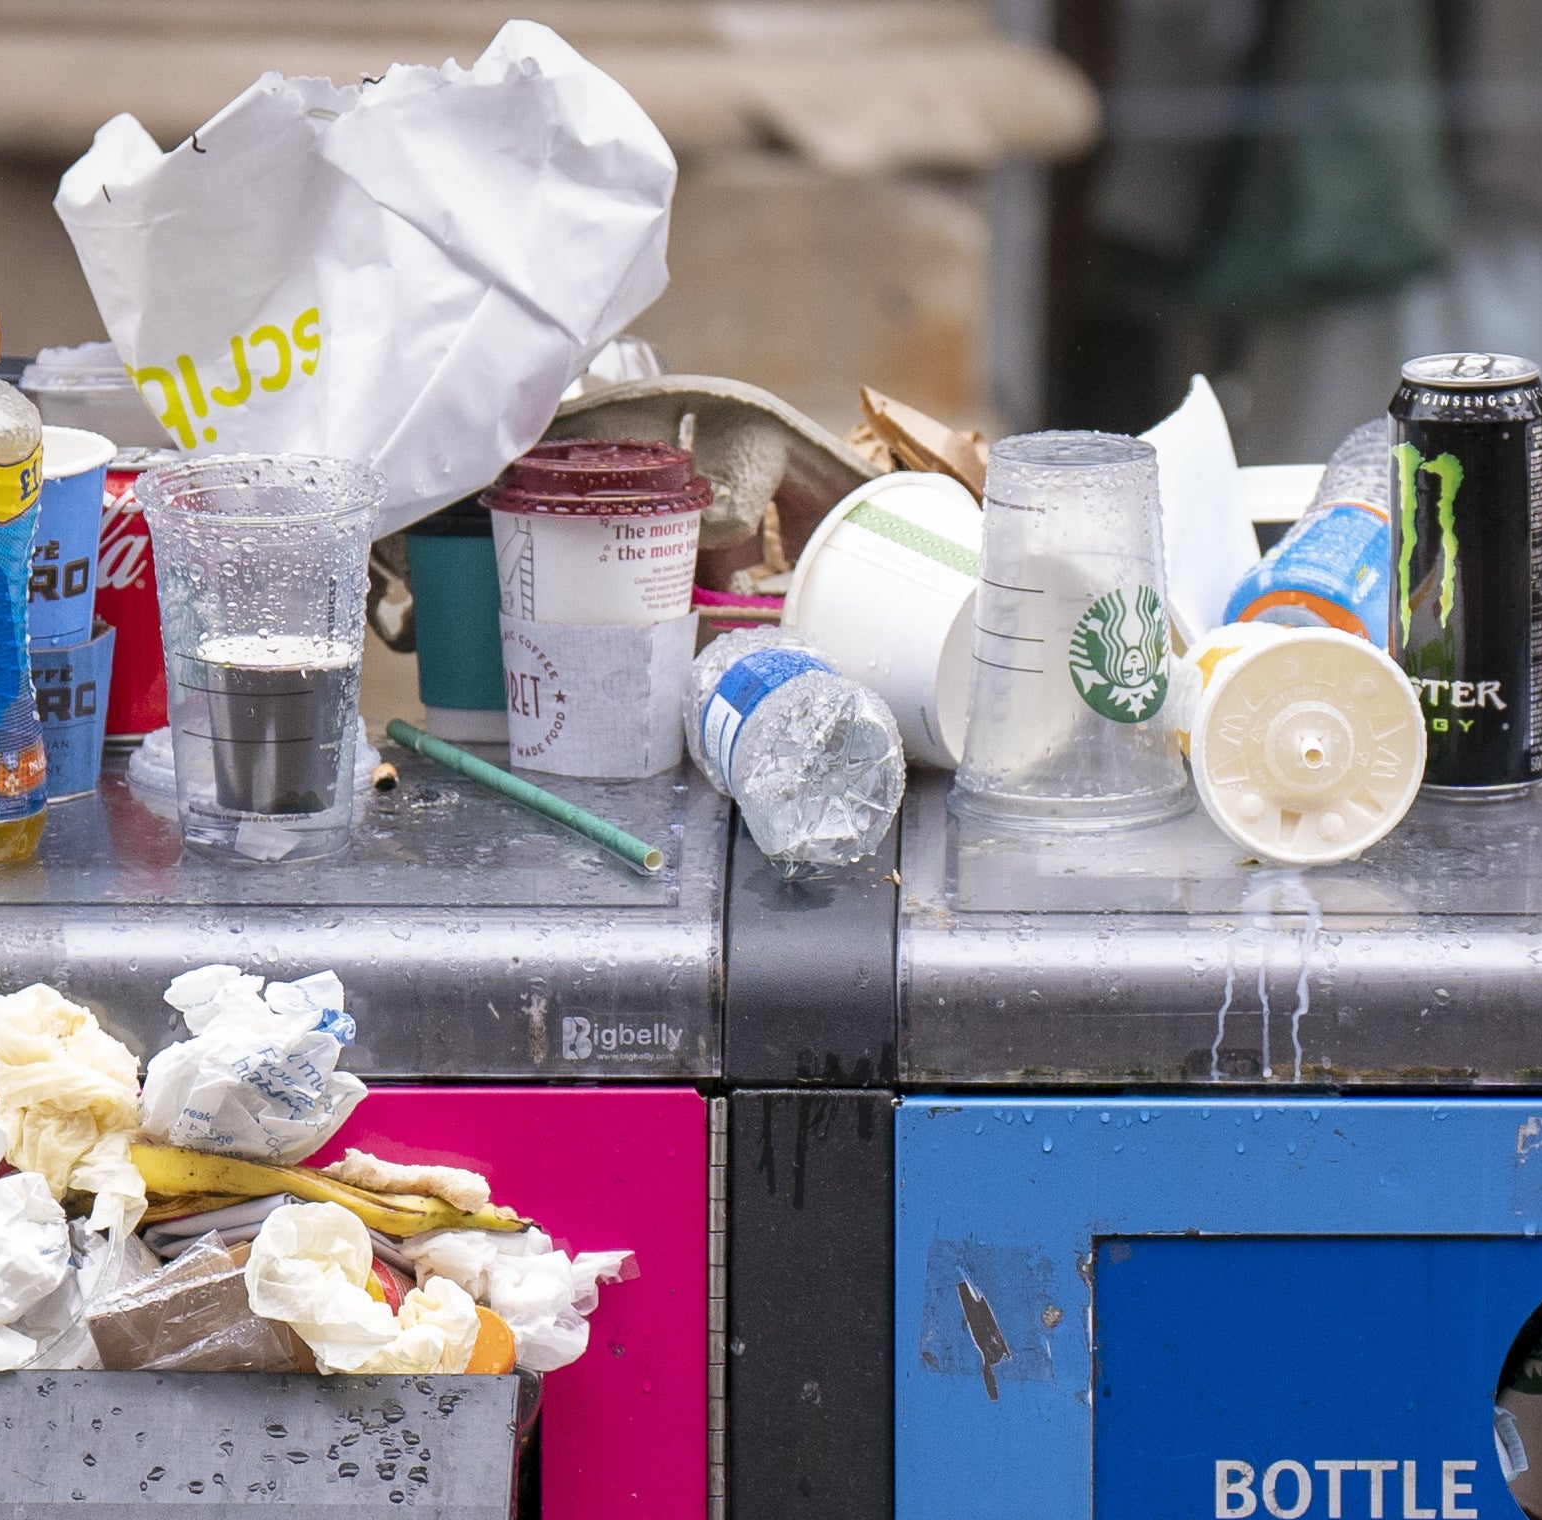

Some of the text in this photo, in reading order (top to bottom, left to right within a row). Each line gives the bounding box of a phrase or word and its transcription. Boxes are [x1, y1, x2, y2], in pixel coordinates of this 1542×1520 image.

[1422, 392, 1497, 408] GINSENG
[612, 523, 645, 540] The
[649, 519, 684, 538] more
[617, 545, 646, 561] the
[650, 540, 684, 558] more
[27, 556, 90, 603] RO
[518, 634, 559, 681] COFFEE
[35, 680, 96, 723] RO
[1215, 1459, 1478, 1520] BOTTLE
